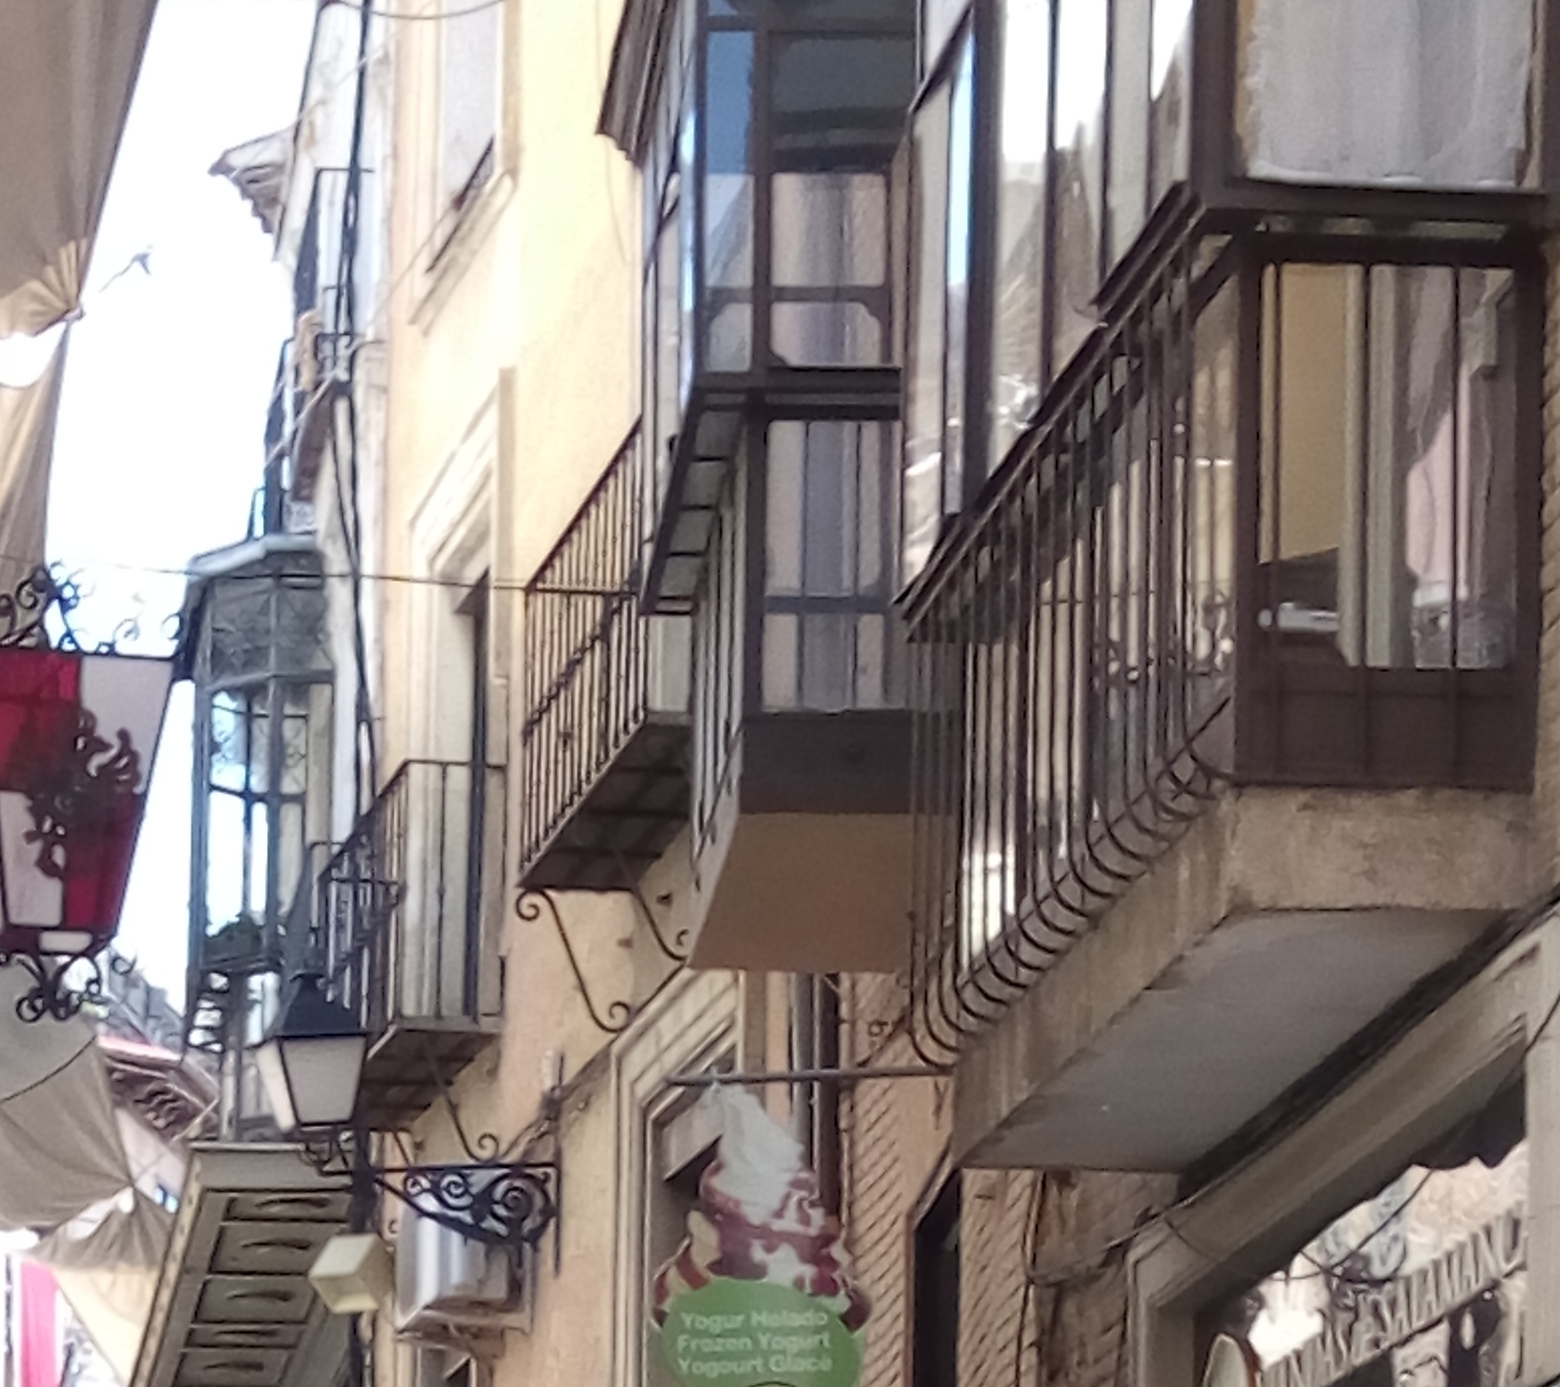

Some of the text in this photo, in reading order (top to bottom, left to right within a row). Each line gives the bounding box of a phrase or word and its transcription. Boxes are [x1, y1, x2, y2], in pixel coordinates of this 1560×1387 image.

[680, 1310, 829, 1334] Yogur Helado
[677, 1331, 832, 1354] Frozen Yogurt
[678, 1357, 765, 1378] Yogourt
